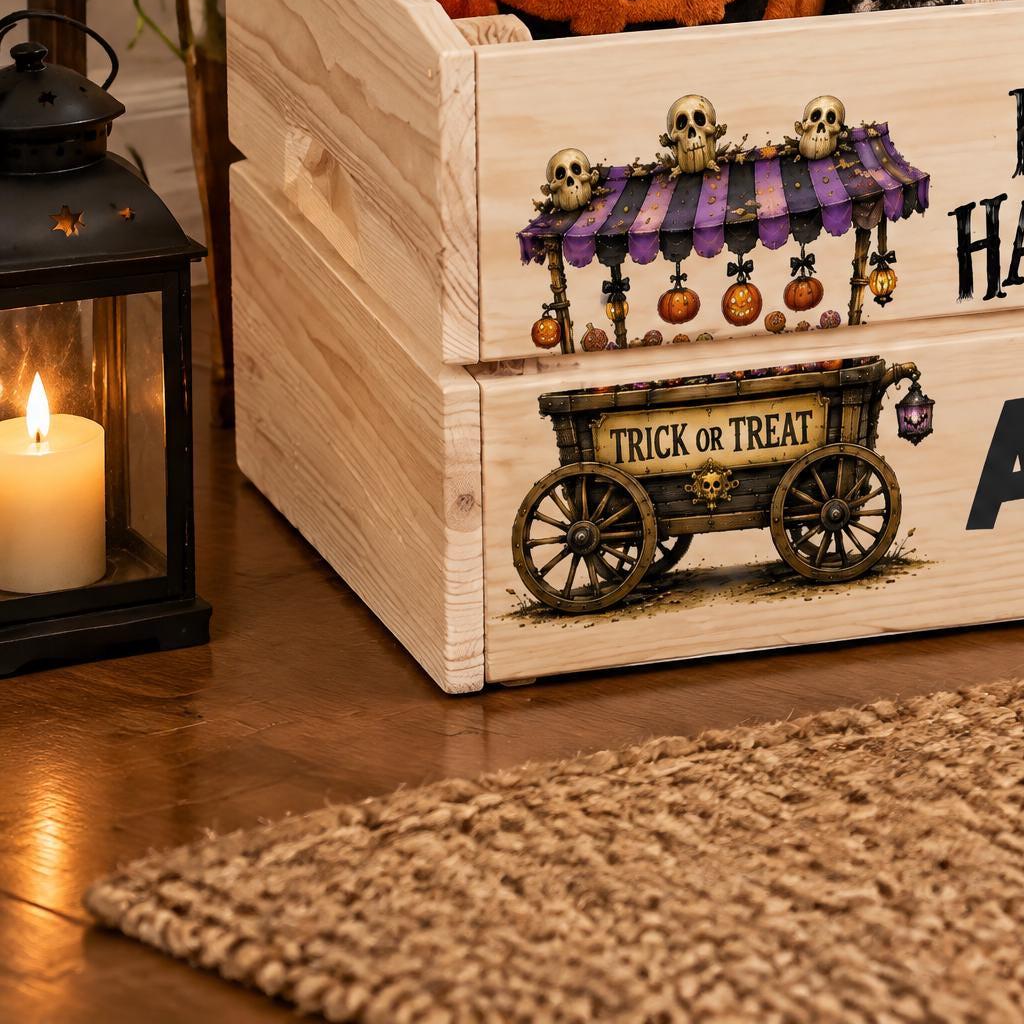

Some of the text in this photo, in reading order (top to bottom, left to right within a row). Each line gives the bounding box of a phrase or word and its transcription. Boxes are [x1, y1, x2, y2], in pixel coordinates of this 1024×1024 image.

[610, 411, 813, 464] TRICK OR TREAT
